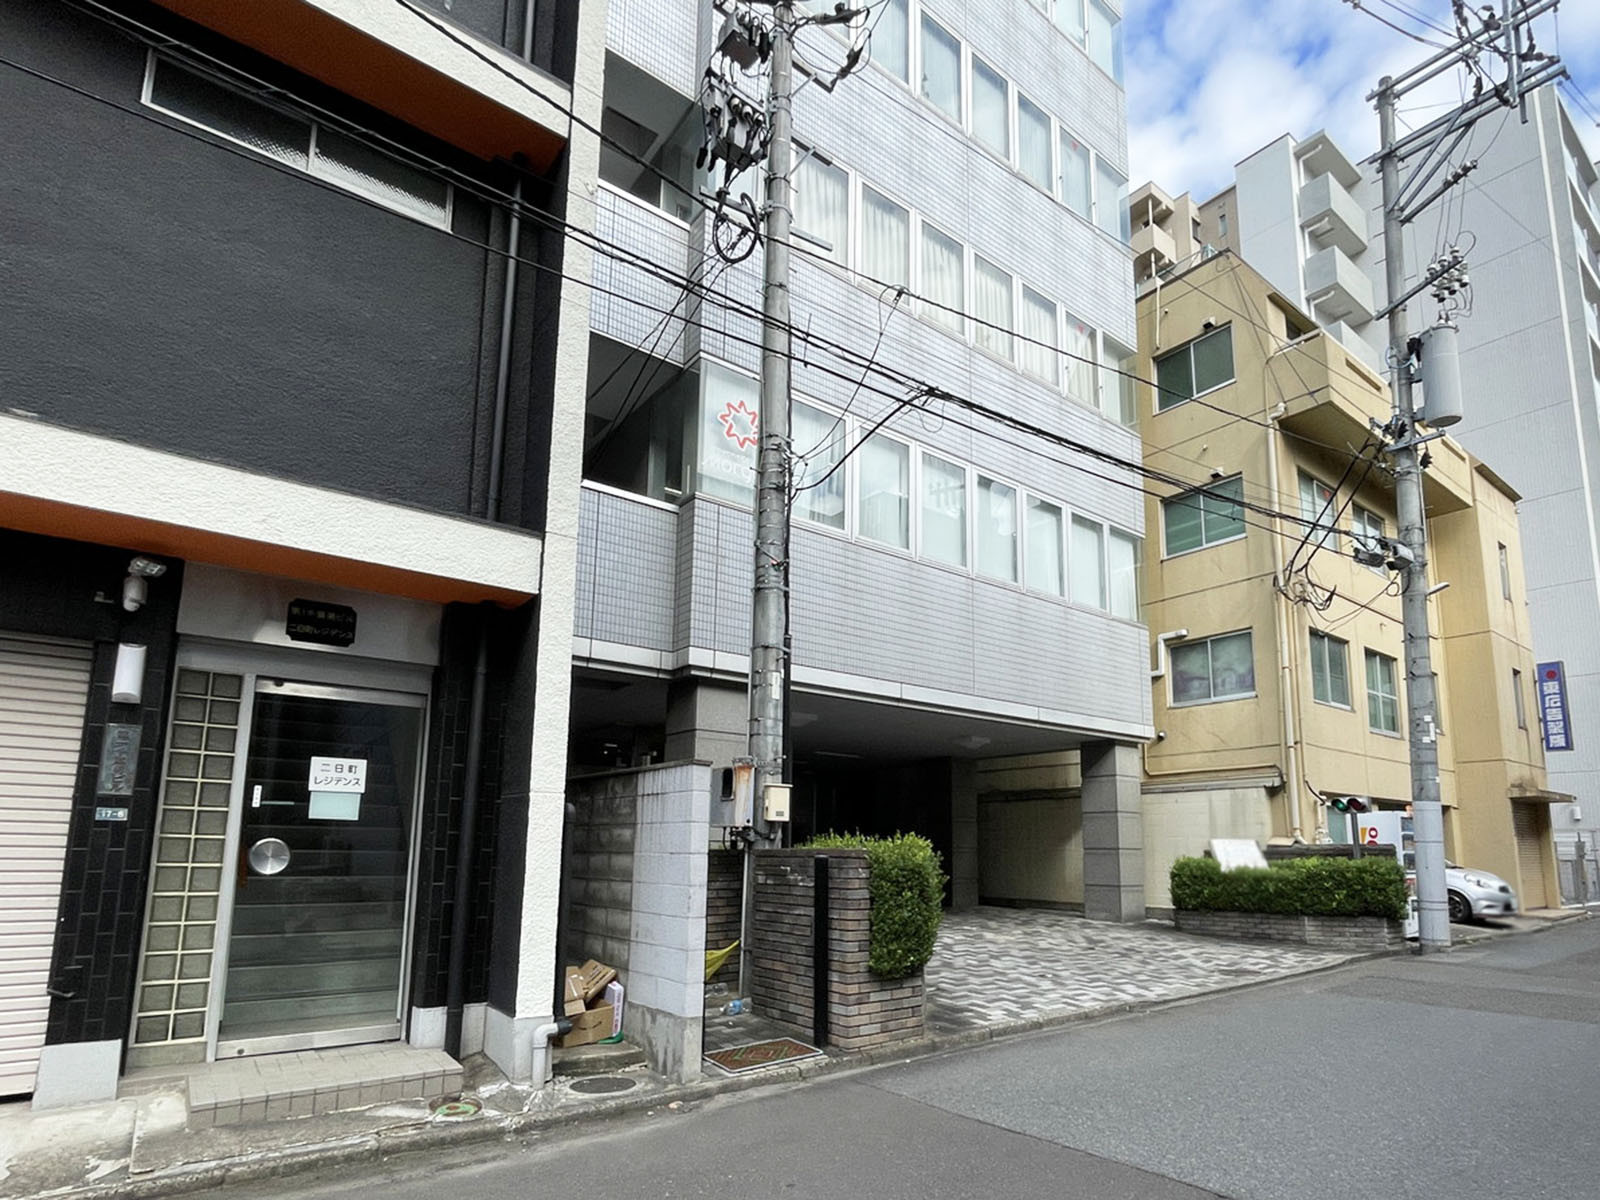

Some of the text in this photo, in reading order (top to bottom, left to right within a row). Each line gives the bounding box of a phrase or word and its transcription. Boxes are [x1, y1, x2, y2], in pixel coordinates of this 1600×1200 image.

[320, 763, 358, 774] 二日町
[314, 776, 361, 786] レジデンス
